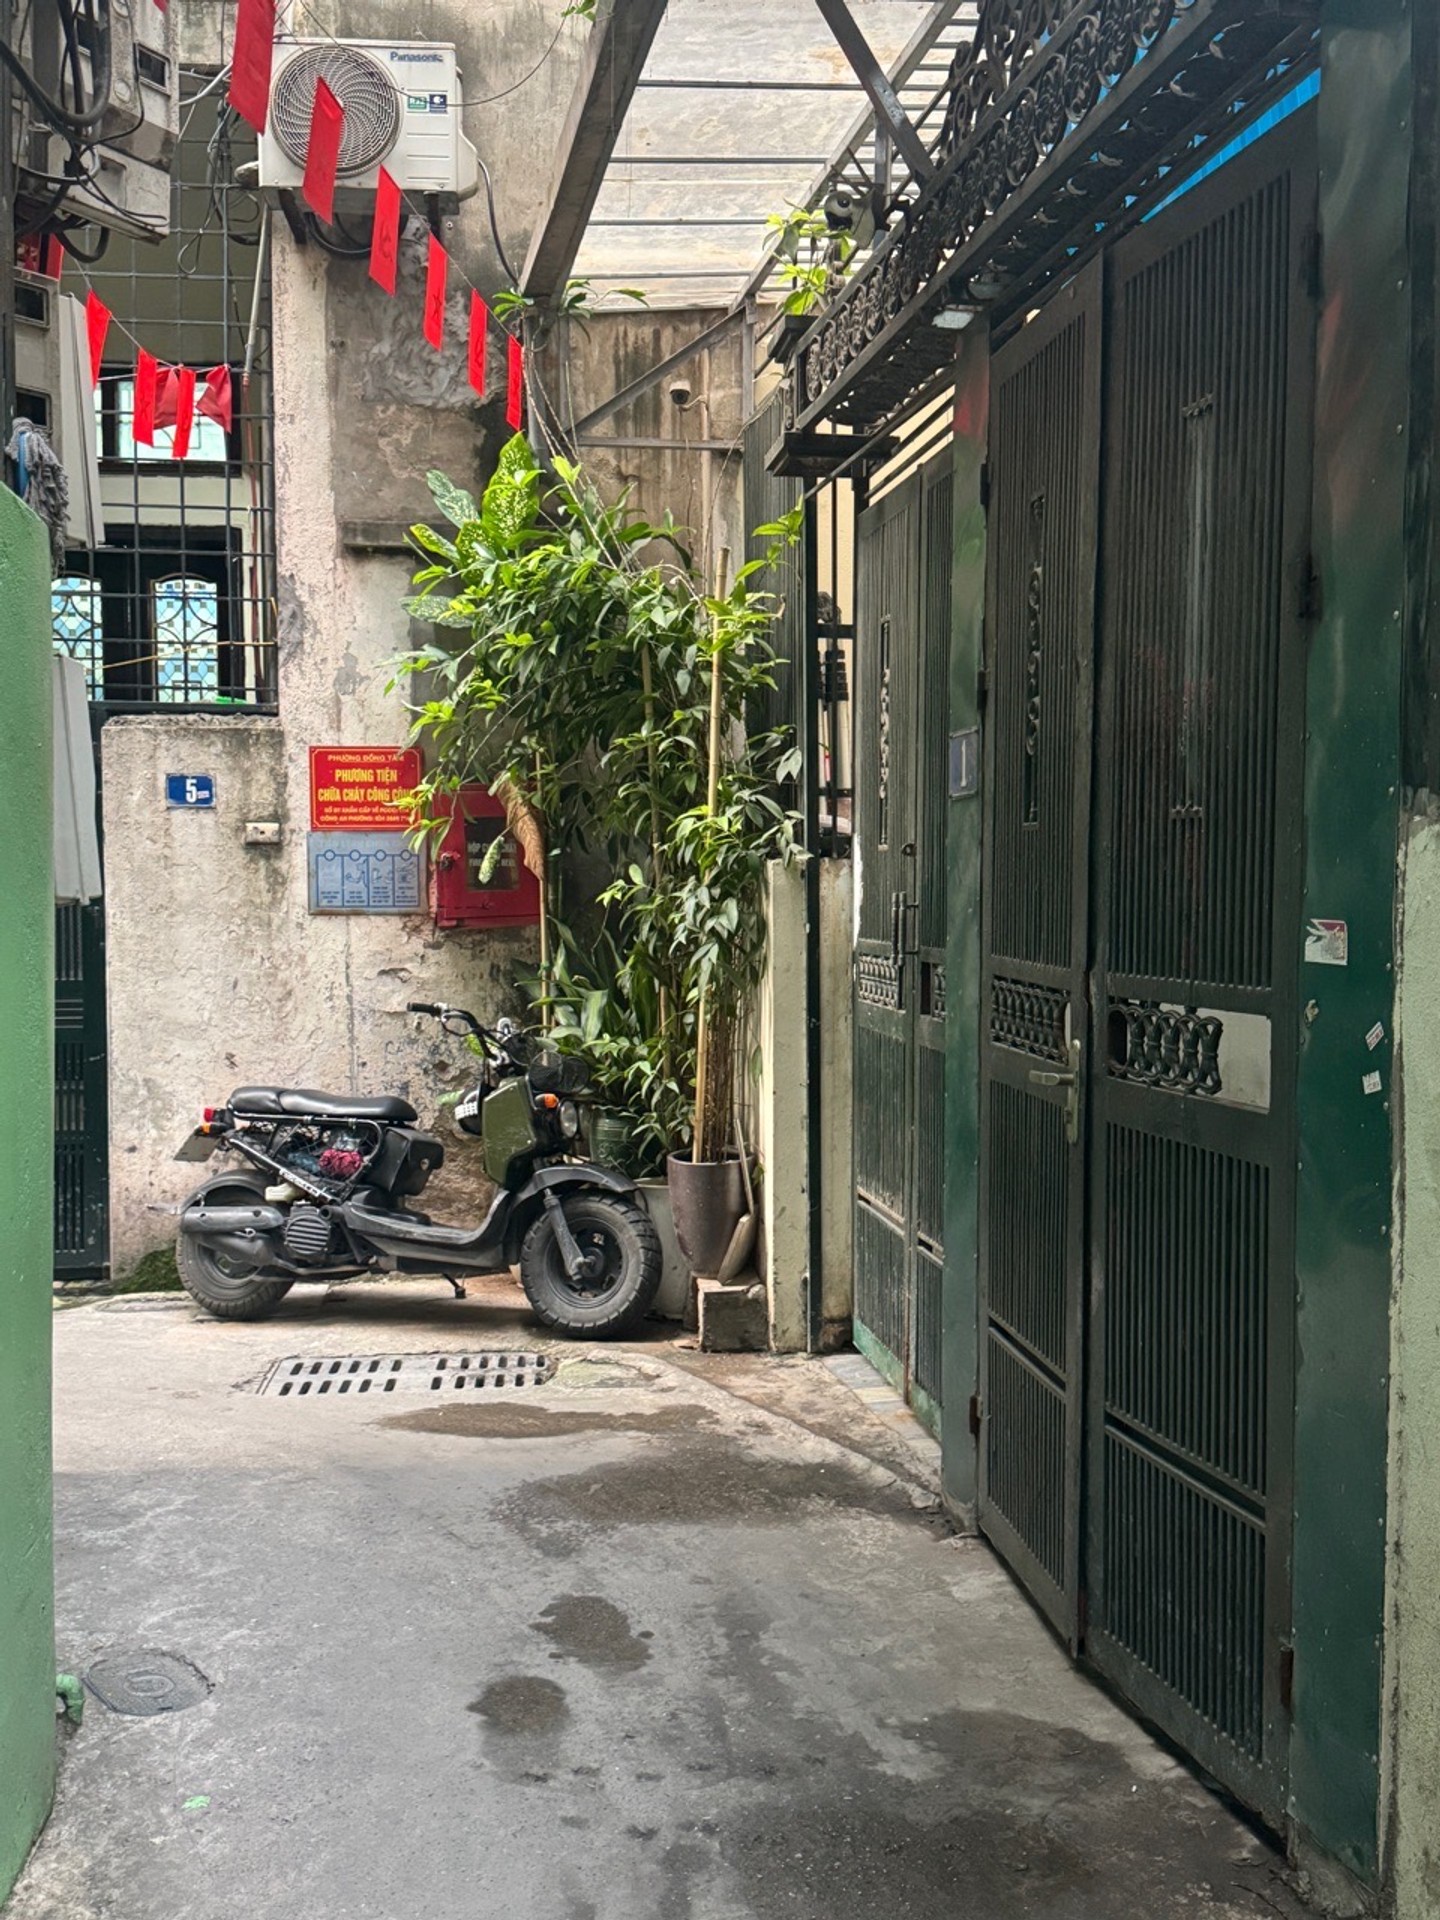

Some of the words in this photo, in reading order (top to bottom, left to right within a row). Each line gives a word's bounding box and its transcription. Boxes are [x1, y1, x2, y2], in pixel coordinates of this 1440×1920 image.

[390, 51, 443, 62] Panasonic
[376, 766, 398, 785] TIỆN
[318, 786, 341, 802] CHỮA
[343, 786, 365, 803] CHÁY
[366, 786, 390, 802] CÔNG
